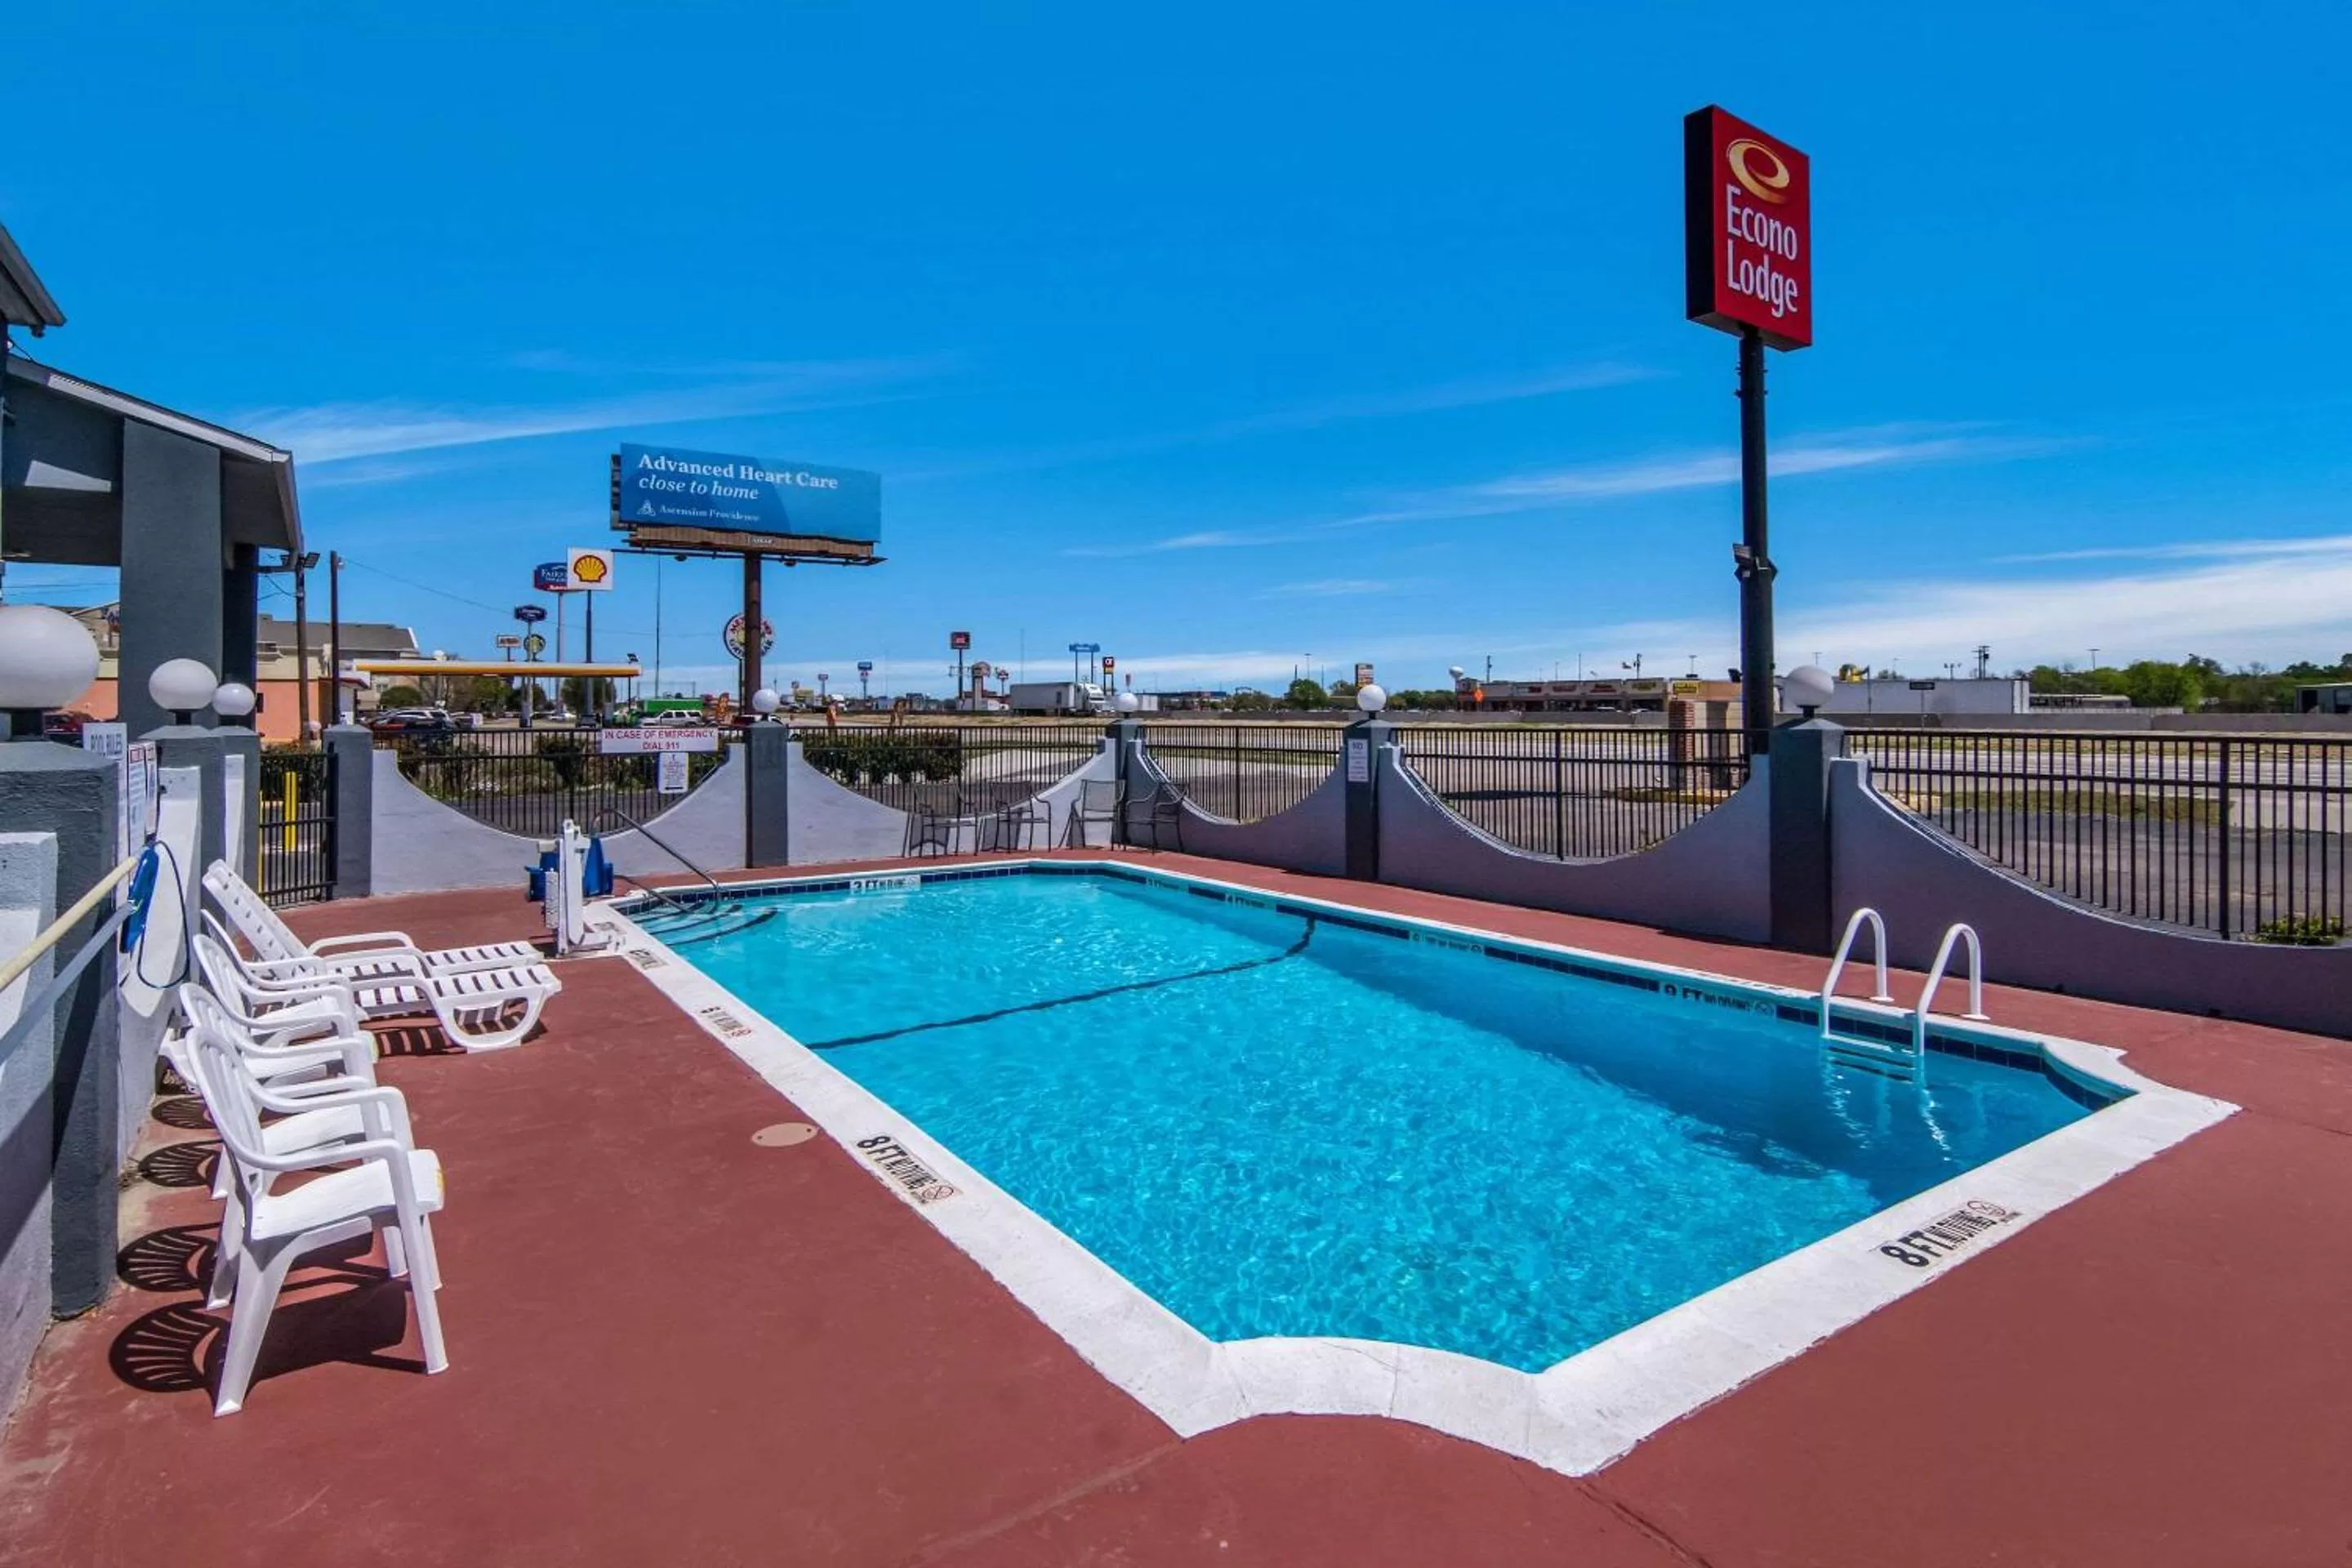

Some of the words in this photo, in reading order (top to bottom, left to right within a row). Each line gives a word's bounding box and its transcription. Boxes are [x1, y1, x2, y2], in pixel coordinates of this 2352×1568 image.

[1726, 183, 1797, 261] Econo
[1727, 238, 1798, 318] Lodge
[639, 453, 733, 479] Advanced
[739, 465, 792, 485] Heart
[796, 472, 838, 490] Care
[639, 474, 686, 492] close
[689, 478, 708, 494] to
[710, 480, 760, 500] home
[659, 504, 707, 517] Ascension
[604, 730, 614, 739] IN
[617, 730, 641, 739] CASE
[644, 730, 656, 739] OF
[658, 729, 715, 739] EMERGENCY
[642, 742, 665, 751] DIAL
[666, 742, 679, 751] 911
[856, 1135, 892, 1148] 8
[1880, 1245, 1930, 1267] 8
